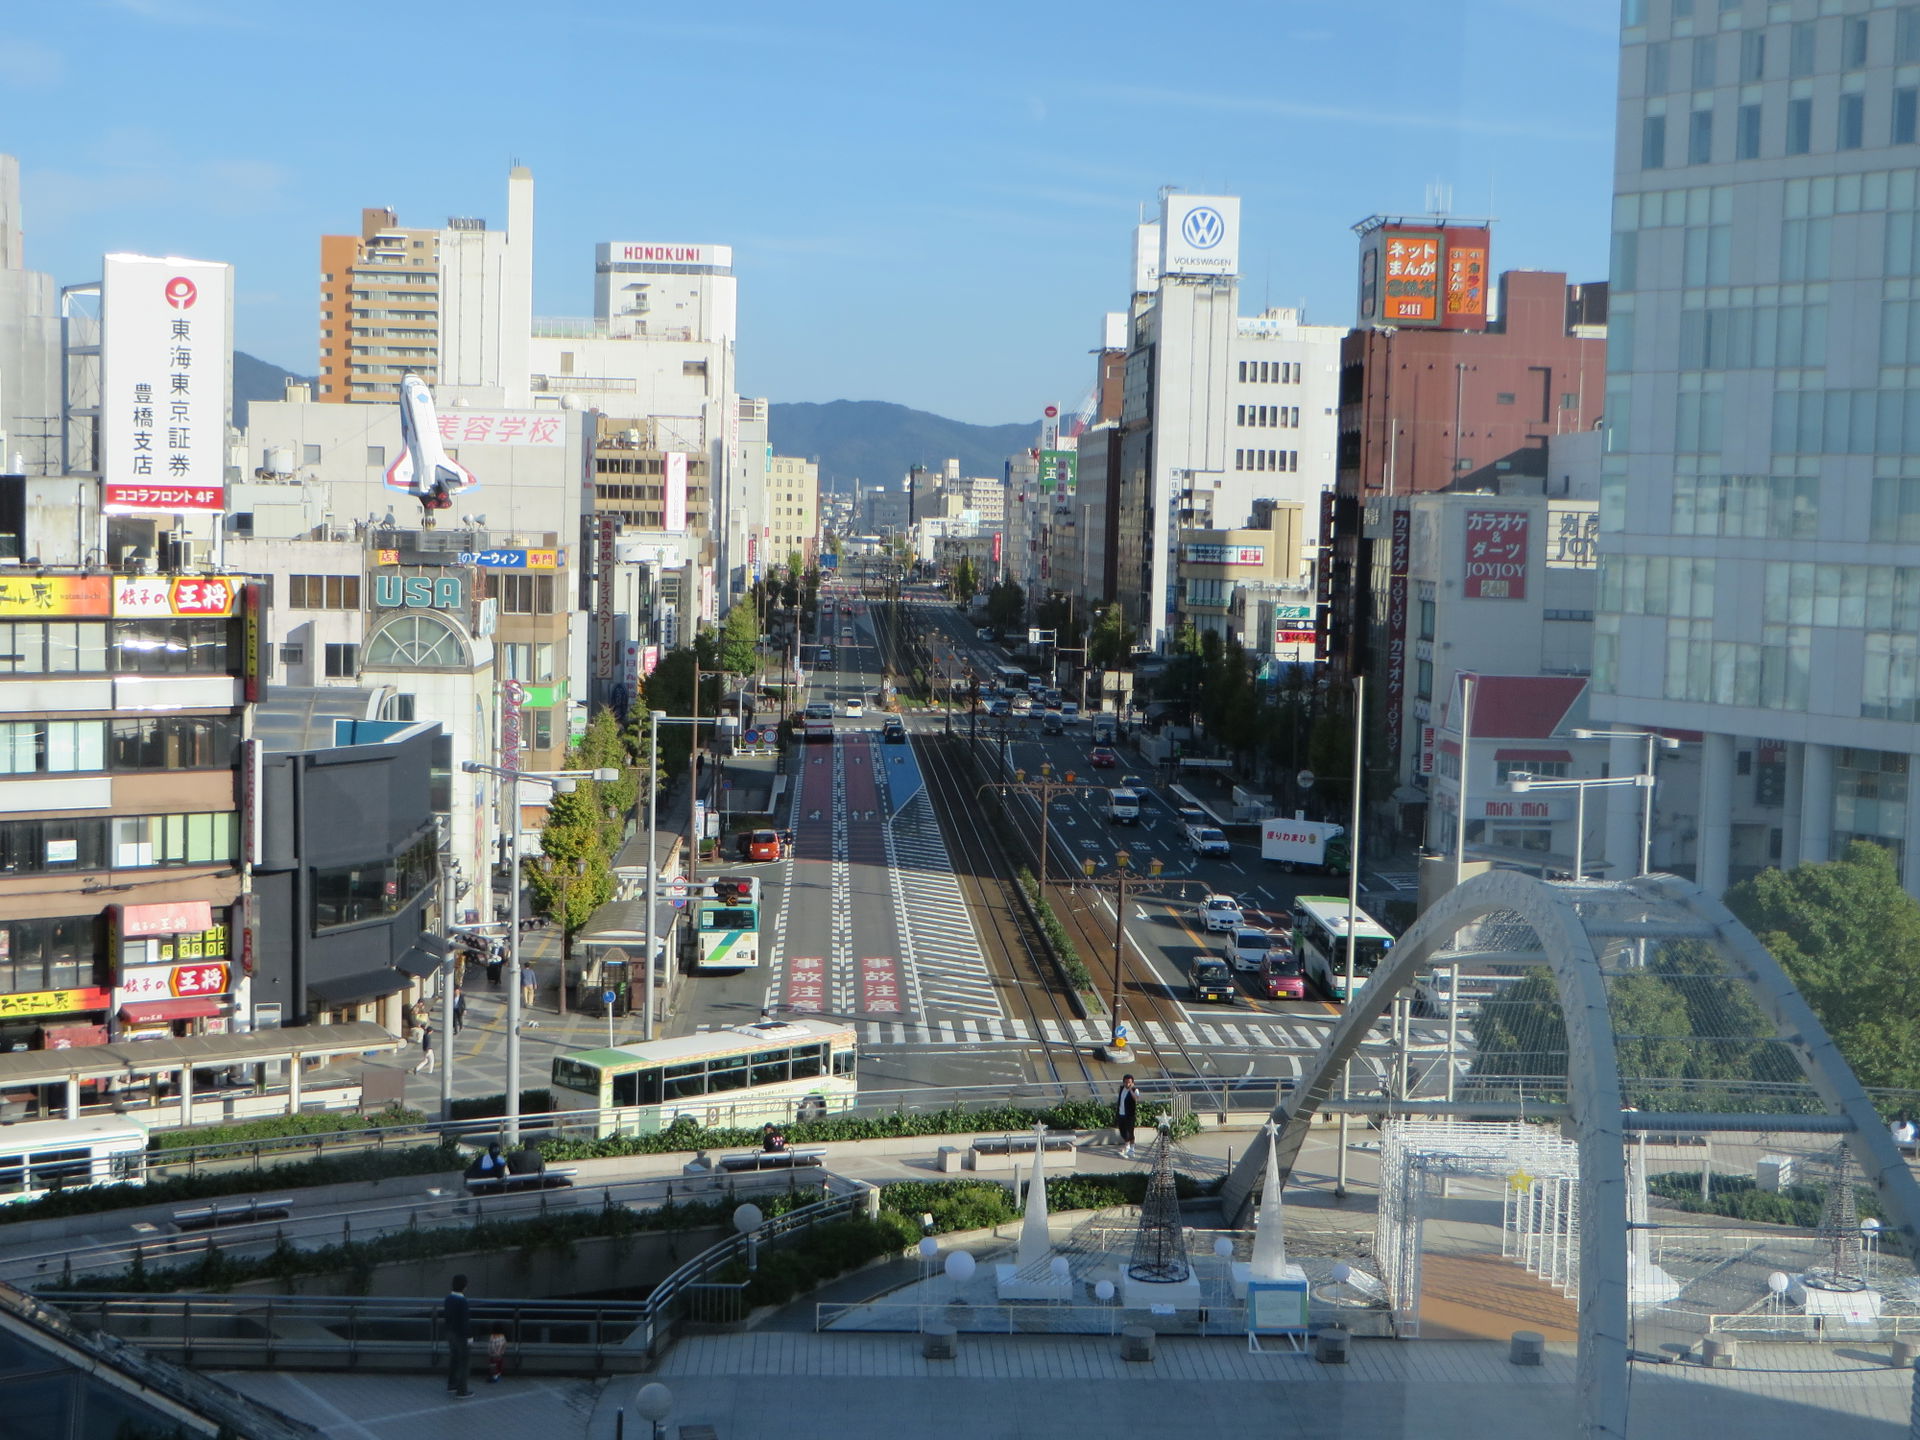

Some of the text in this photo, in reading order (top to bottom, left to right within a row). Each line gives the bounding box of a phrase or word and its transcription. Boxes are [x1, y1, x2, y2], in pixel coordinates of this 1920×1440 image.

[624, 246, 701, 262] HONOKUNI
[1388, 242, 1435, 259] ネット
[1174, 257, 1231, 267] VOLKSWAGEN
[1388, 261, 1436, 276] まんが
[168, 318, 192, 477] 東海東京証券
[132, 383, 154, 476] 豊橋支店
[436, 415, 561, 444] 美容学校
[115, 488, 215, 504] ココラフロント 4F
[1468, 513, 1527, 531] カラオケ
[1393, 515, 1408, 571] カラオケ
[1492, 531, 1502, 543] &
[1473, 541, 1520, 559] ダーツ
[530, 554, 553, 566] 専門
[1465, 562, 1526, 580] JOYJOY
[119, 584, 227, 609] 餃子の王将
[376, 575, 462, 609] USA
[1389, 640, 1403, 693] カラオケ
[1485, 802, 1548, 817] mini mini
[123, 967, 223, 994] 餃子の王将
[790, 958, 823, 1013] 事故注意
[864, 958, 898, 1013] 事故注意
